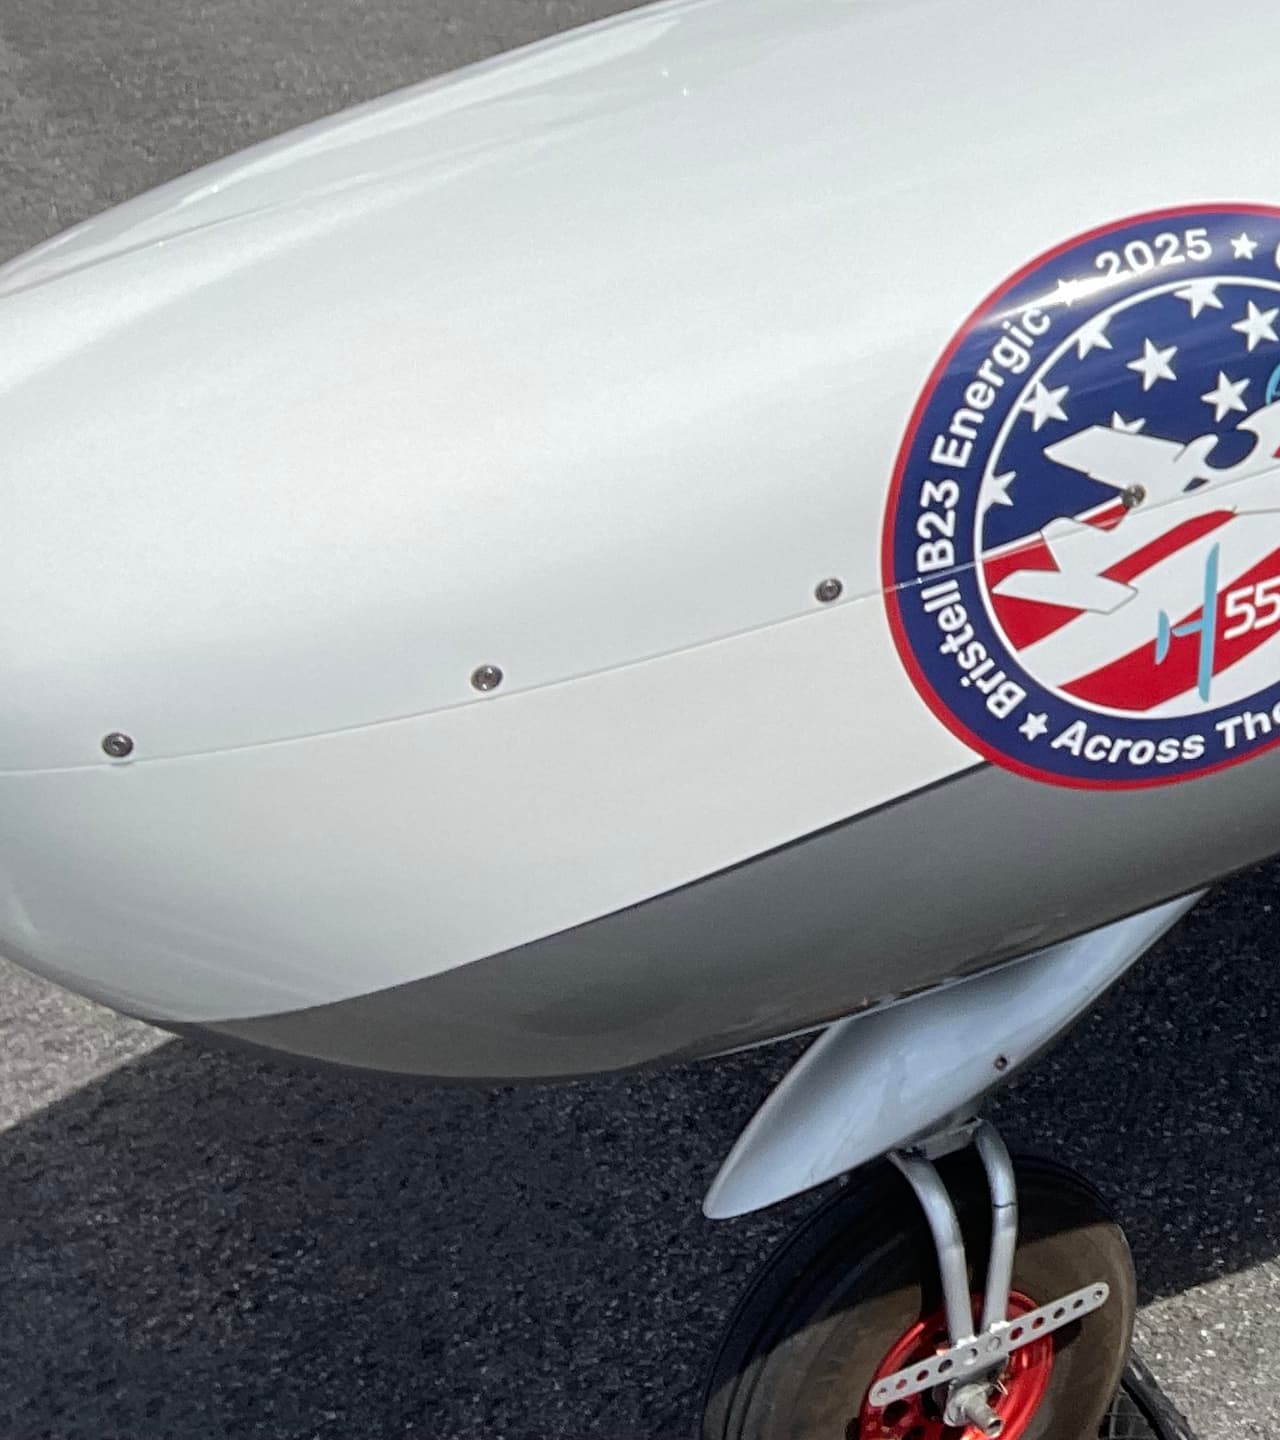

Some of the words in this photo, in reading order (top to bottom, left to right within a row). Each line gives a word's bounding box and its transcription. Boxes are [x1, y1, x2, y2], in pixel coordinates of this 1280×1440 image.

[1095, 228, 1212, 281] 2025
[930, 308, 1052, 467] Energic
[916, 479, 960, 572] B23
[919, 580, 1026, 719] Bristell
[1051, 720, 1206, 764] Across
